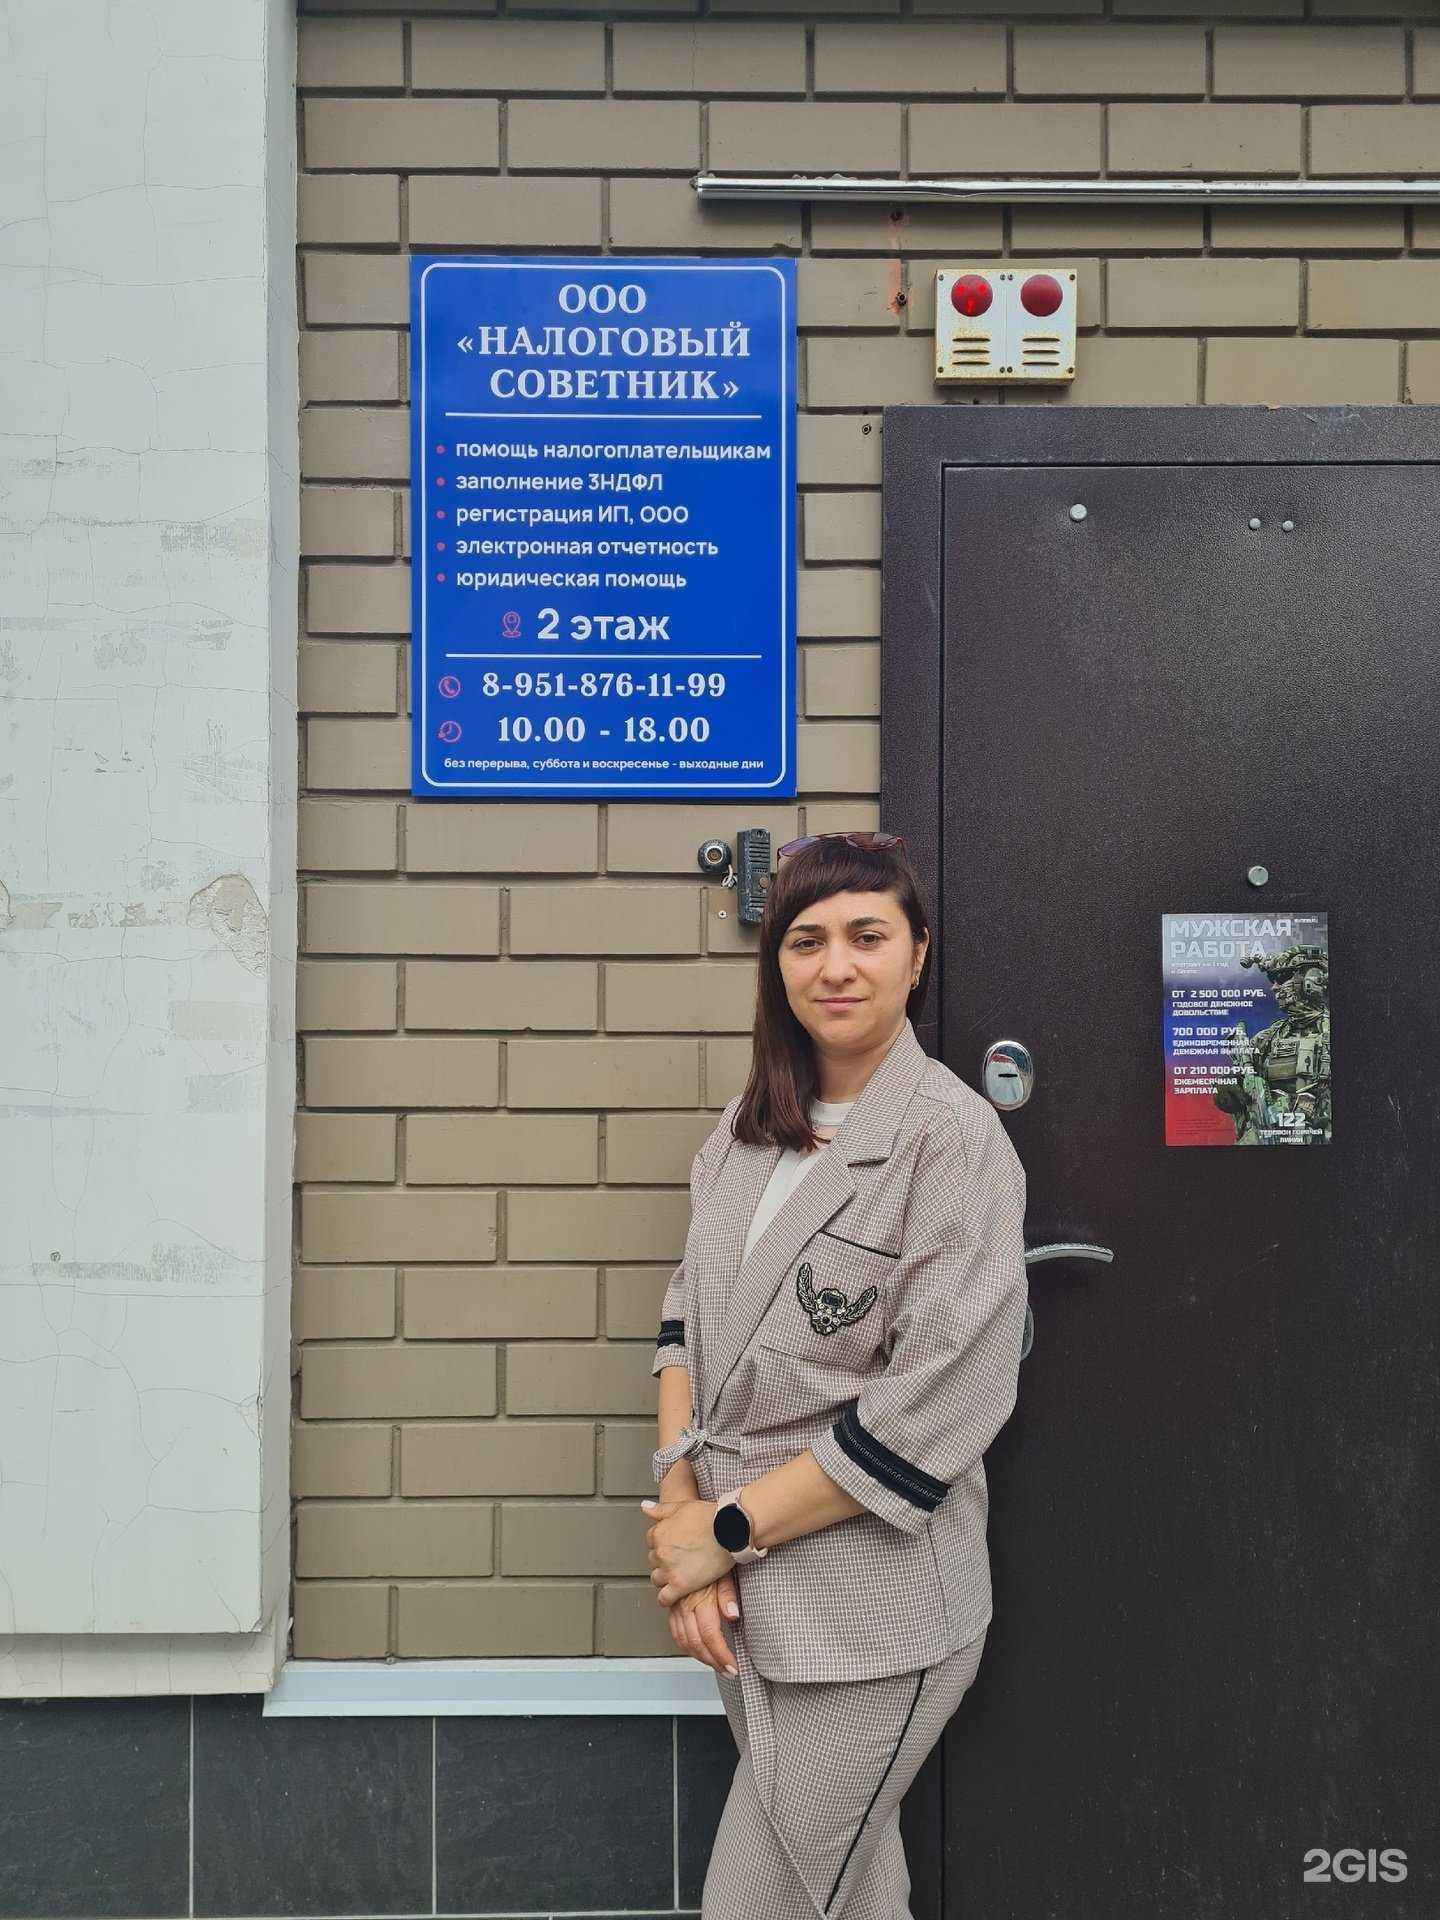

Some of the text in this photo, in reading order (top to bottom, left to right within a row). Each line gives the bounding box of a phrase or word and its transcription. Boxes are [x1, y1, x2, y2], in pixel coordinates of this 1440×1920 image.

[558, 284, 647, 314] ООО
[456, 321, 751, 357] «НАЛОГОВЫЙ
[490, 369, 740, 400] СОВЕТНИК»
[456, 443, 771, 461] помощь налогоплательщикам
[456, 475, 584, 491] заполнение
[456, 506, 689, 527] регистрация ИП, ООО
[456, 539, 719, 558] электронная отчетность
[456, 571, 687, 591] юридическая помощь
[537, 607, 671, 641] 2 этаж
[482, 672, 727, 698] 8-951-876-11-99
[497, 716, 586, 743] 10.00
[624, 717, 711, 743] 18.00
[444, 758, 466, 769] без
[468, 760, 530, 771] перерыва,
[533, 758, 581, 771] суббота
[583, 760, 590, 769] и
[592, 760, 670, 772] воскресенье
[679, 760, 740, 770] выходные
[741, 760, 764, 770] дни
[1170, 918, 1292, 937] МУЖСКАЯ
[1170, 940, 1267, 958] РАБОТА
[1172, 989, 1267, 998] ОТ 2 500 000 РУБ.
[1172, 1027, 1193, 1036] 700
[1196, 1027, 1218, 1036] 000
[1174, 1066, 1188, 1075] ОТ
[1190, 1066, 1207, 1075] 210
[1210, 1066, 1230, 1075] 000
[1277, 1112, 1306, 1127] 122
